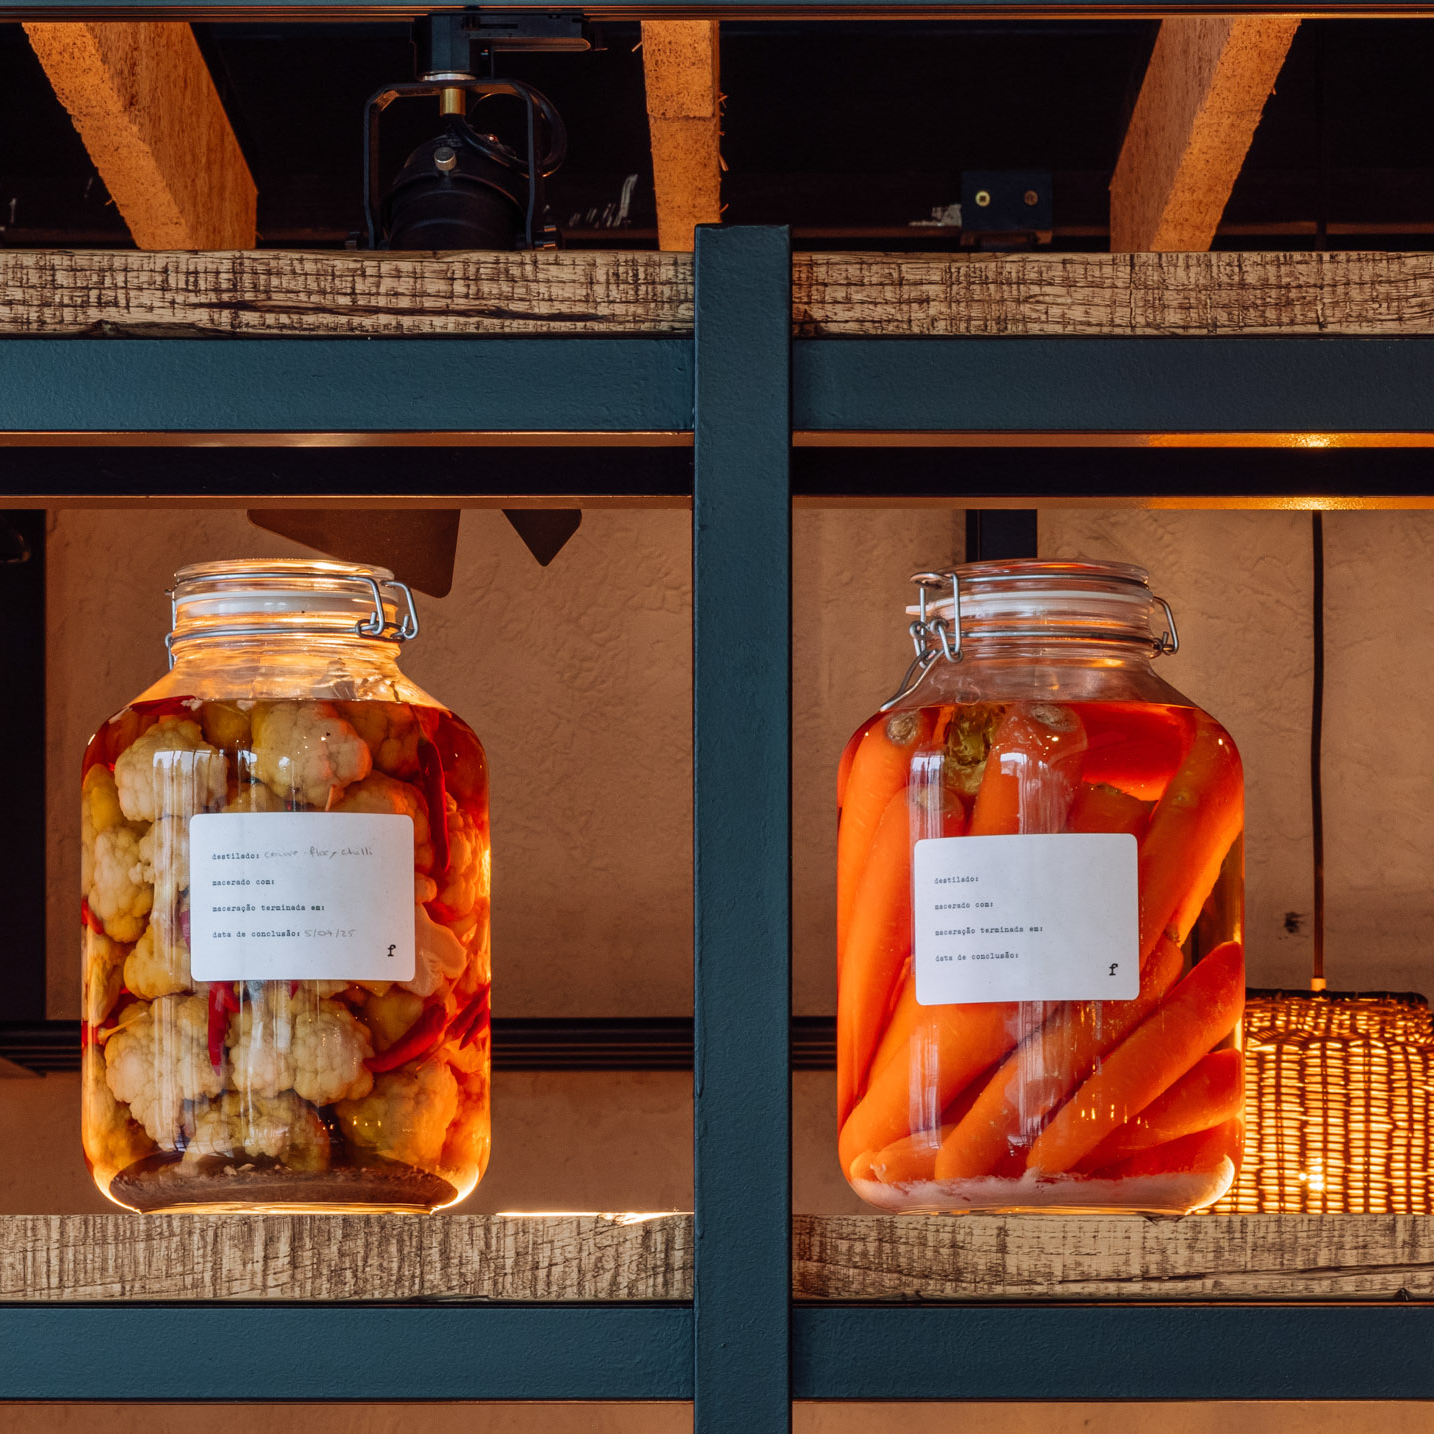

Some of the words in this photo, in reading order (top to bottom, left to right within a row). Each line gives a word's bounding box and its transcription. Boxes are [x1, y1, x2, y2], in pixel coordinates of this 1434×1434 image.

[211, 852, 260, 861] destilado:
[211, 878, 251, 887] macerado
[934, 875, 979, 885] destilado:
[211, 903, 257, 913] maceração
[260, 903, 307, 912] terminada
[310, 904, 325, 912] em:
[934, 901, 971, 911] macerado
[974, 901, 994, 909] com:
[212, 931, 232, 939] data
[235, 930, 247, 938] de
[250, 929, 301, 938] conclusão:
[934, 926, 976, 937] maceração
[979, 925, 1024, 934] terminada
[386, 943, 397, 958] f
[934, 954, 954, 963] data
[956, 953, 967, 962] de
[970, 951, 1019, 961] conclusão:
[1107, 962, 1119, 977] f
